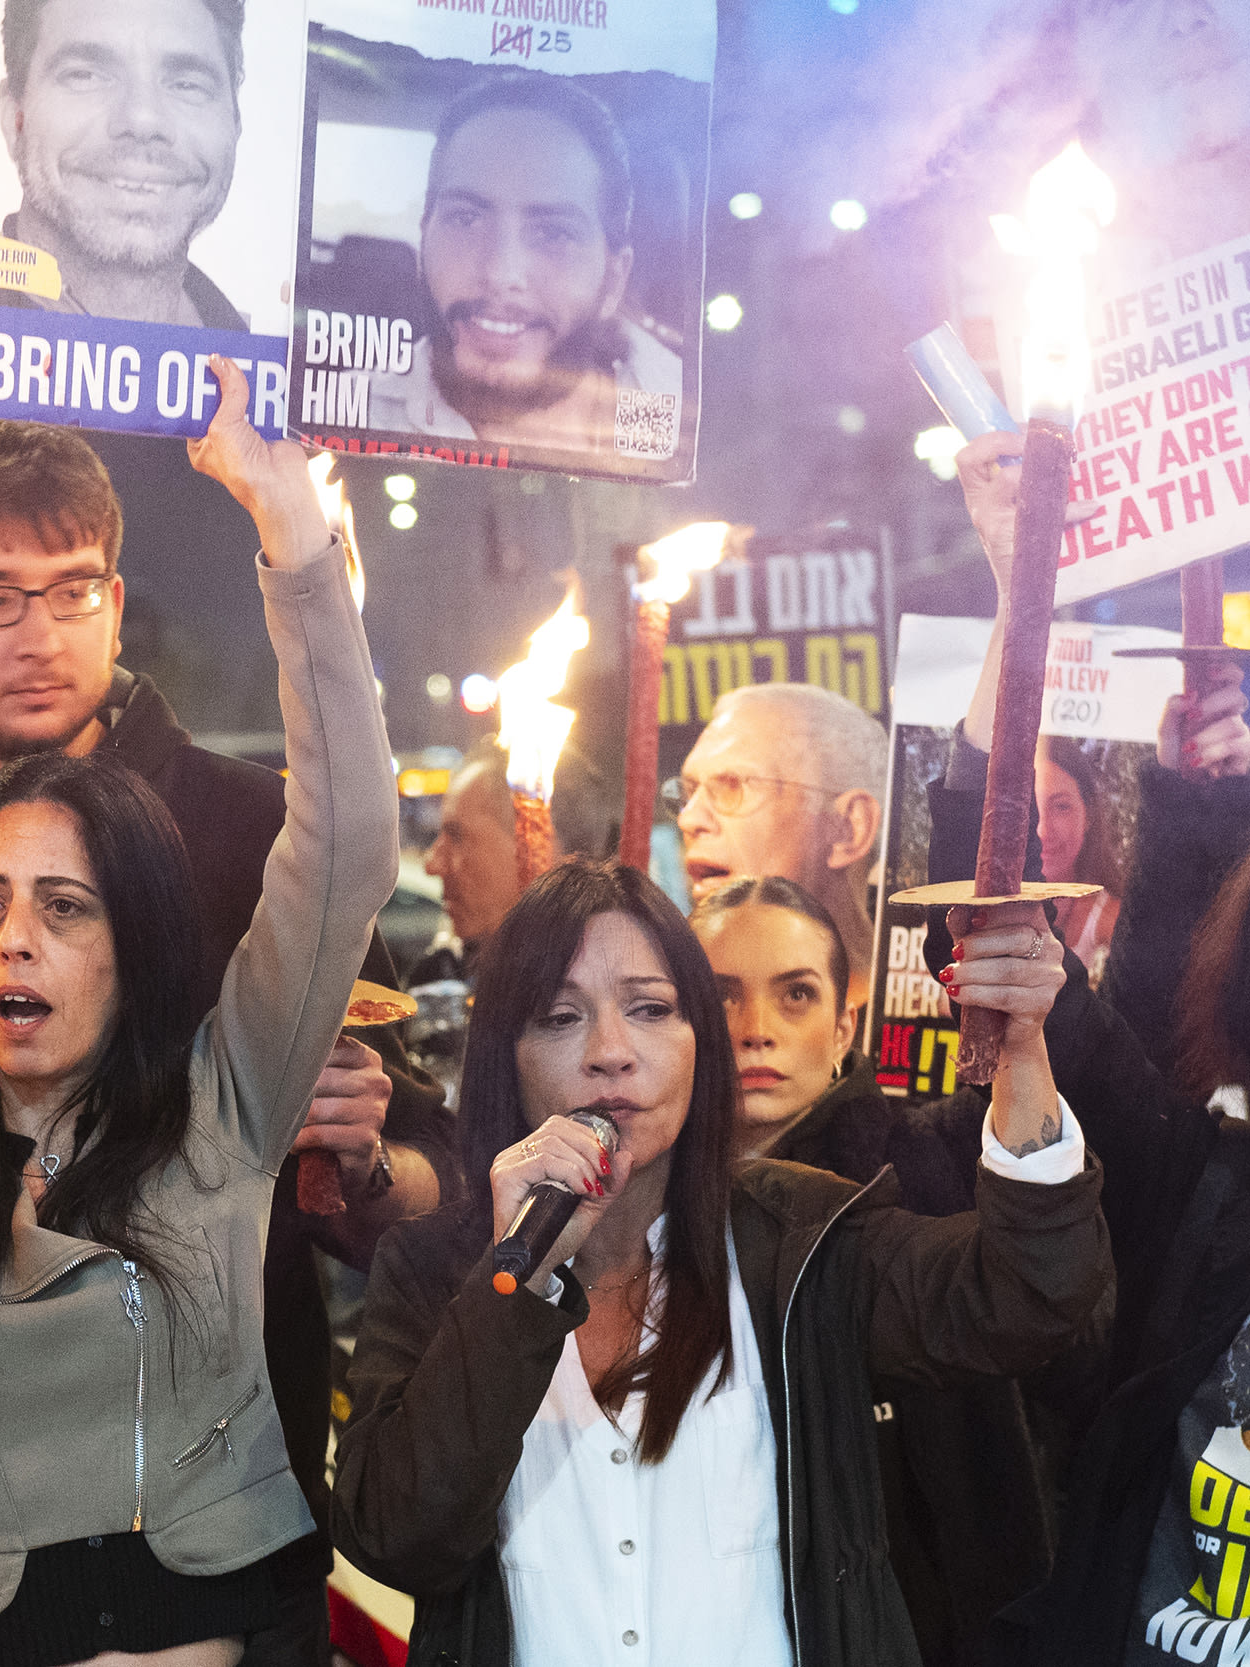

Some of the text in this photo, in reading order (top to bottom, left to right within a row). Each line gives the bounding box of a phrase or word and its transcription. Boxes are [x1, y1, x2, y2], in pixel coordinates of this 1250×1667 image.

[491, 0, 607, 29] ZANGAUKER
[537, 30, 572, 53] 25
[1091, 282, 1170, 348] IFE
[1175, 271, 1200, 315] IS
[1203, 260, 1229, 305] IN
[305, 308, 413, 374] BRING
[1092, 313, 1229, 394] ISRAELI
[157, 350, 286, 428] OFR
[302, 368, 370, 429] HIM
[1068, 406, 1244, 502] HEY ARE
[1068, 667, 1109, 693] LEVY
[1051, 696, 1101, 727] (20)
[884, 972, 941, 1018] HER
[1193, 1530, 1221, 1556] OR
